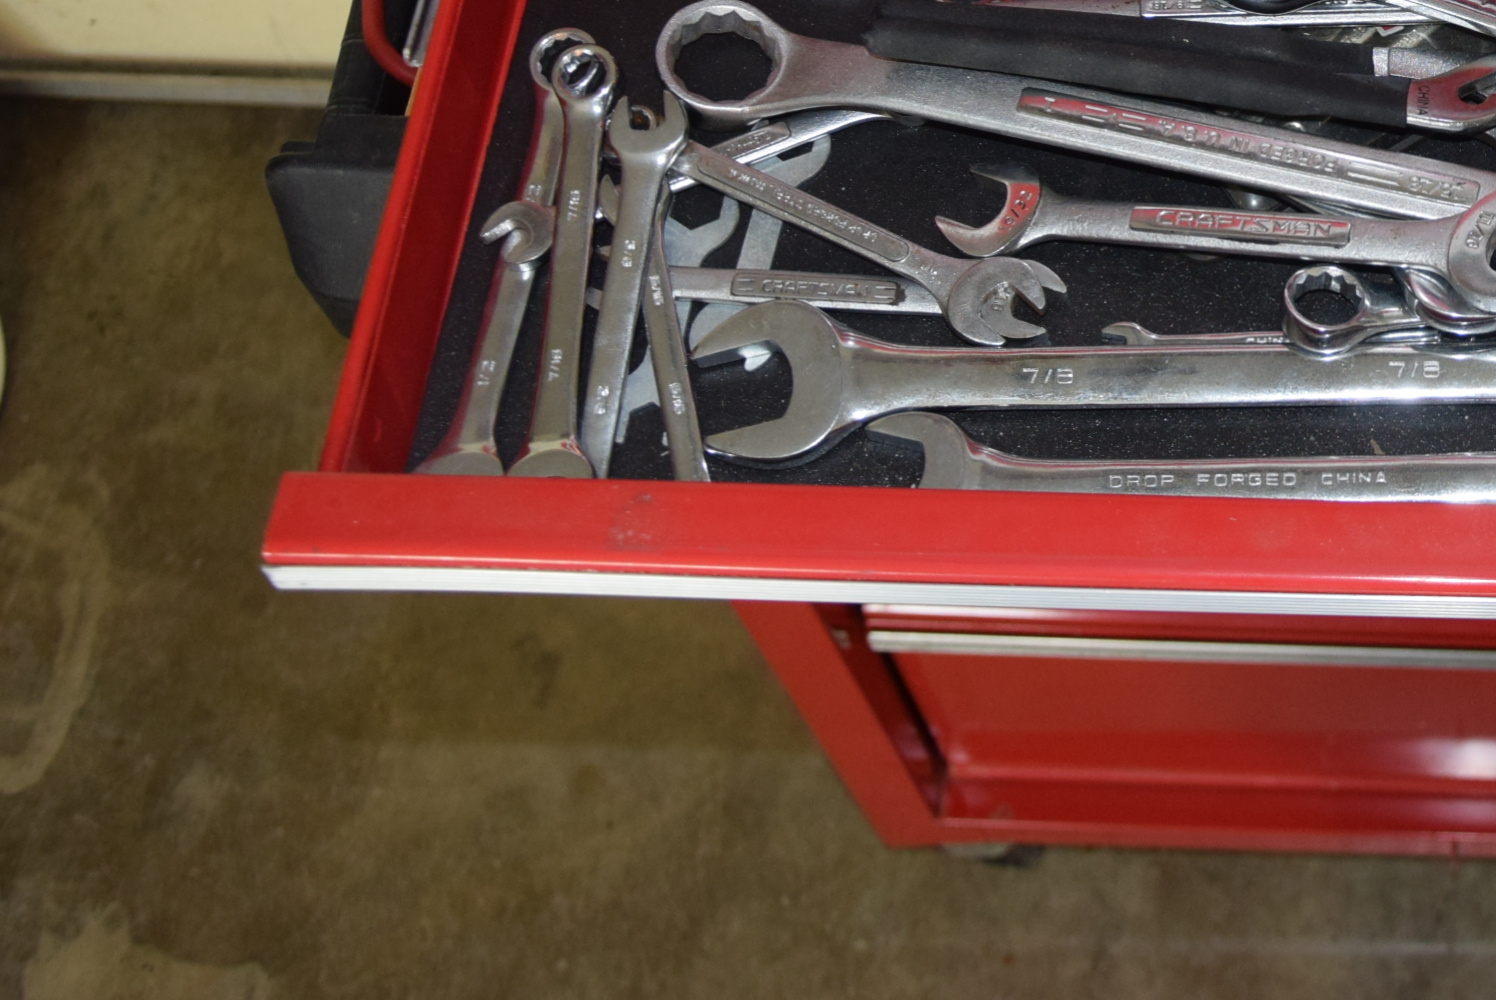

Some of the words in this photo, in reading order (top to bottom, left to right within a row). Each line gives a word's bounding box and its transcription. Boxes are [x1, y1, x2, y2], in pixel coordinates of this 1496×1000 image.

[1416, 85, 1430, 117] CHINA
[1231, 136, 1250, 155] IN
[1260, 141, 1339, 174] FORGED
[1155, 209, 1333, 238] CRAFTSMAN
[761, 278, 872, 298] CRAFTSMAN
[1022, 367, 1074, 385] 7/8
[1388, 359, 1442, 379] 7/8
[1109, 474, 1175, 488] DROP
[1197, 471, 1298, 487] FORGED
[1321, 470, 1387, 486] CHINA
